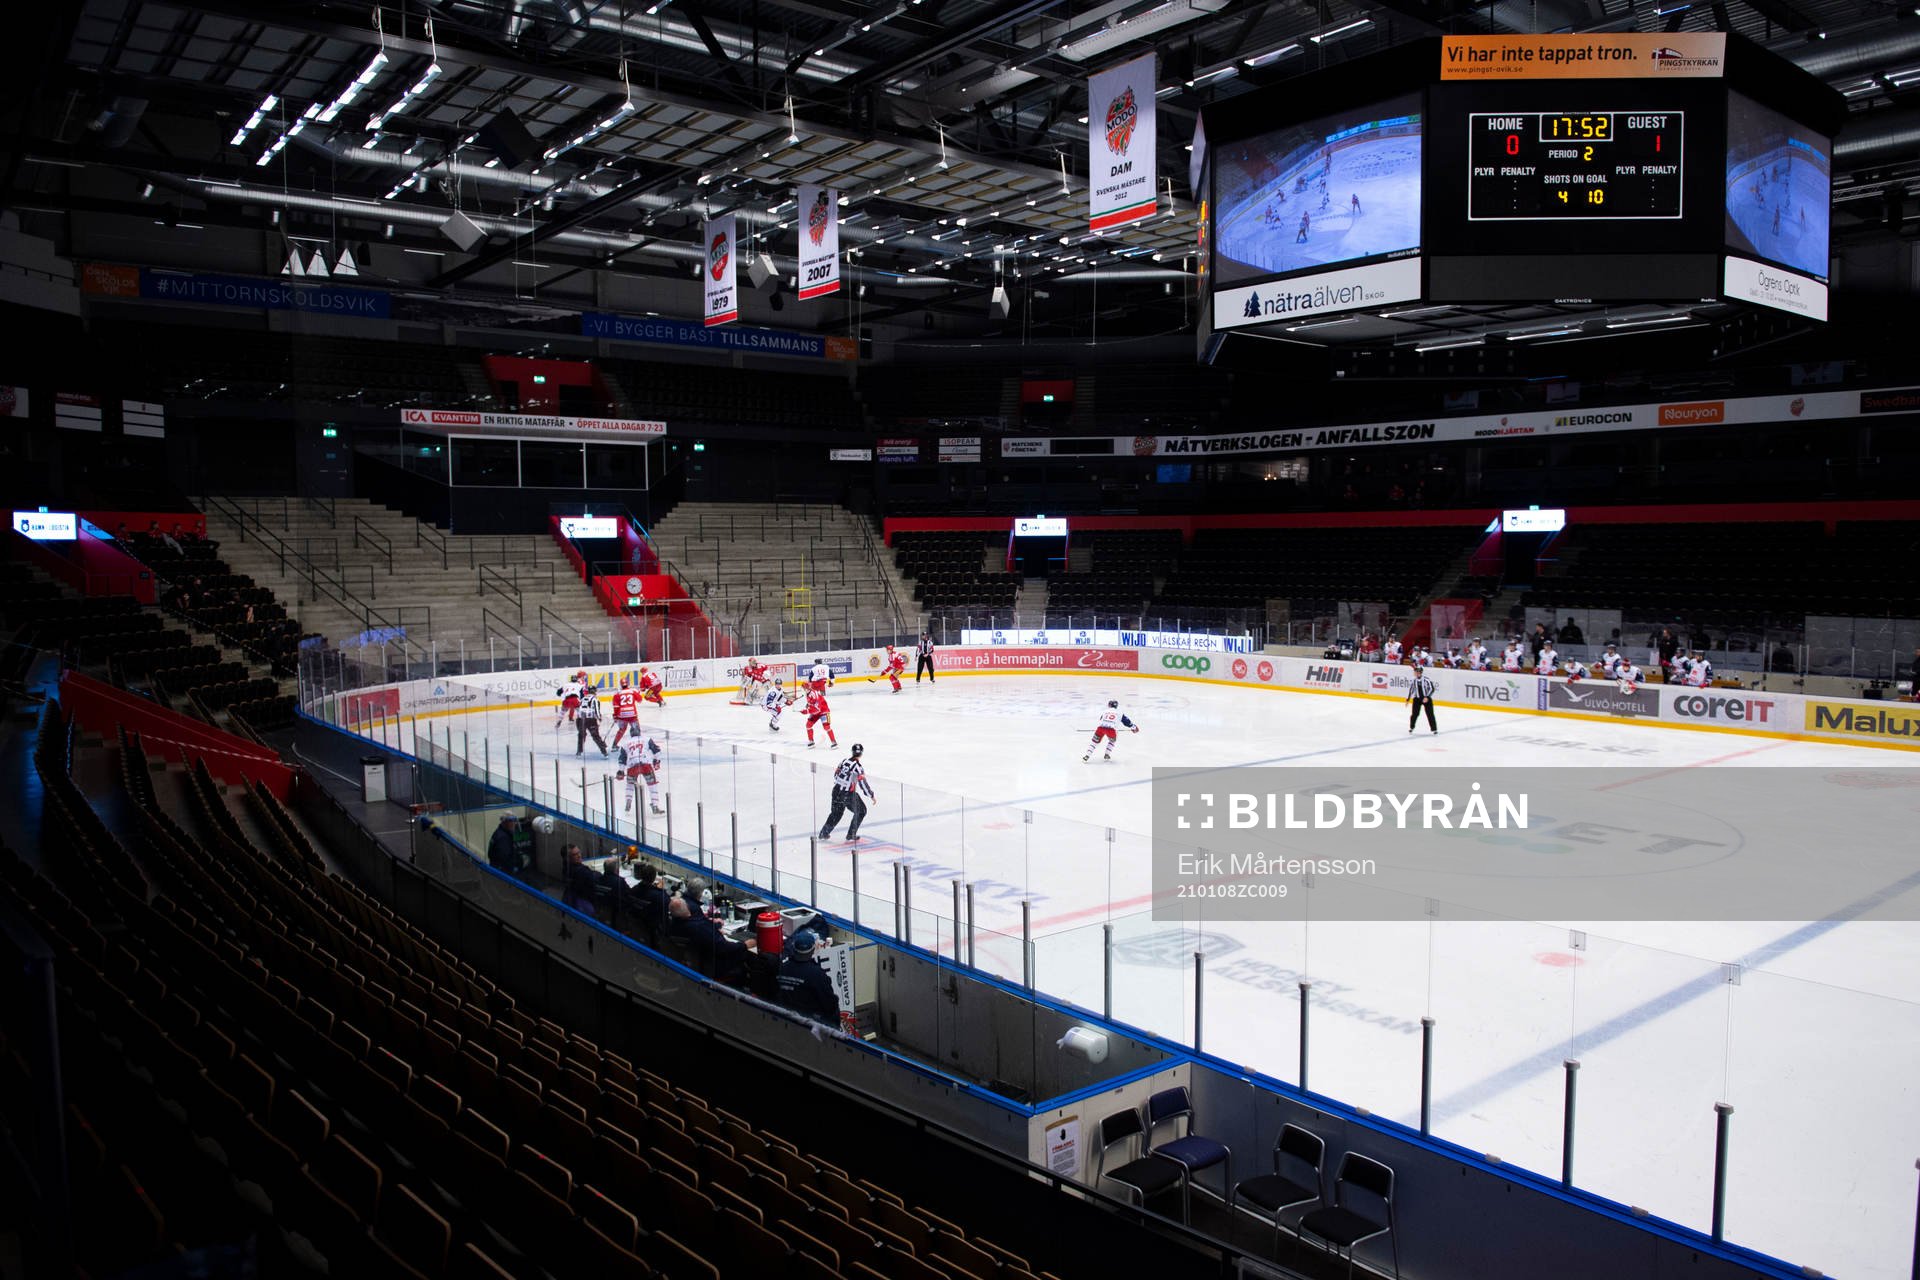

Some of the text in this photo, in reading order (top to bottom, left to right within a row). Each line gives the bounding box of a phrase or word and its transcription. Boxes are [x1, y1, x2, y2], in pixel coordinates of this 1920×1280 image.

[1448, 45, 1637, 64] Vi har inte tappat tron.
[1659, 59, 1718, 67] PINGSTKYRKAN
[1107, 104, 1137, 133] MODO
[1488, 116, 1667, 137] HOME 17:52 GUEST
[1506, 134, 1661, 155] 0 1
[1548, 146, 1594, 161] PERIOD 2
[1110, 161, 1132, 177] DAM
[1474, 165, 1677, 176] PLYR PENALTY PLYR PENALTY
[1544, 174, 1608, 184] SHOTS ON GOAL
[1096, 184, 1120, 197] SVENSKA
[1114, 191, 1127, 201] 2012
[1558, 189, 1604, 204] 4 10
[807, 264, 832, 282] 2007
[712, 296, 729, 310] 1979
[1264, 284, 1385, 316] nätraälven SKOG
[615, 321, 674, 340] BYGGER
[721, 331, 818, 353] TILLSAMMANS
[405, 411, 663, 433] ICA KVANTUM EN RIKTIG MATAFFÄR ÖPPET ALLA DAGAR 7-23
[1570, 412, 1632, 426] EUROCON
[1664, 408, 1718, 421] Nouryon
[1165, 432, 1303, 453] NÄTVERKSLOGEN
[1316, 424, 1435, 445] ANFALLSZON
[1121, 632, 1146, 647] WIJO
[935, 652, 1063, 669] Värme på hemmaplan
[1109, 661, 1130, 670] energi
[1162, 653, 1211, 675] coop
[1306, 664, 1344, 683] Hilli
[497, 678, 560, 692] SJÖBLOMS
[1465, 684, 1510, 701] miva
[620, 694, 634, 706] 23
[1612, 701, 1647, 713] HOTELL
[1674, 695, 1774, 722] coreIT
[840, 950, 850, 1006] CARSTEDTS
